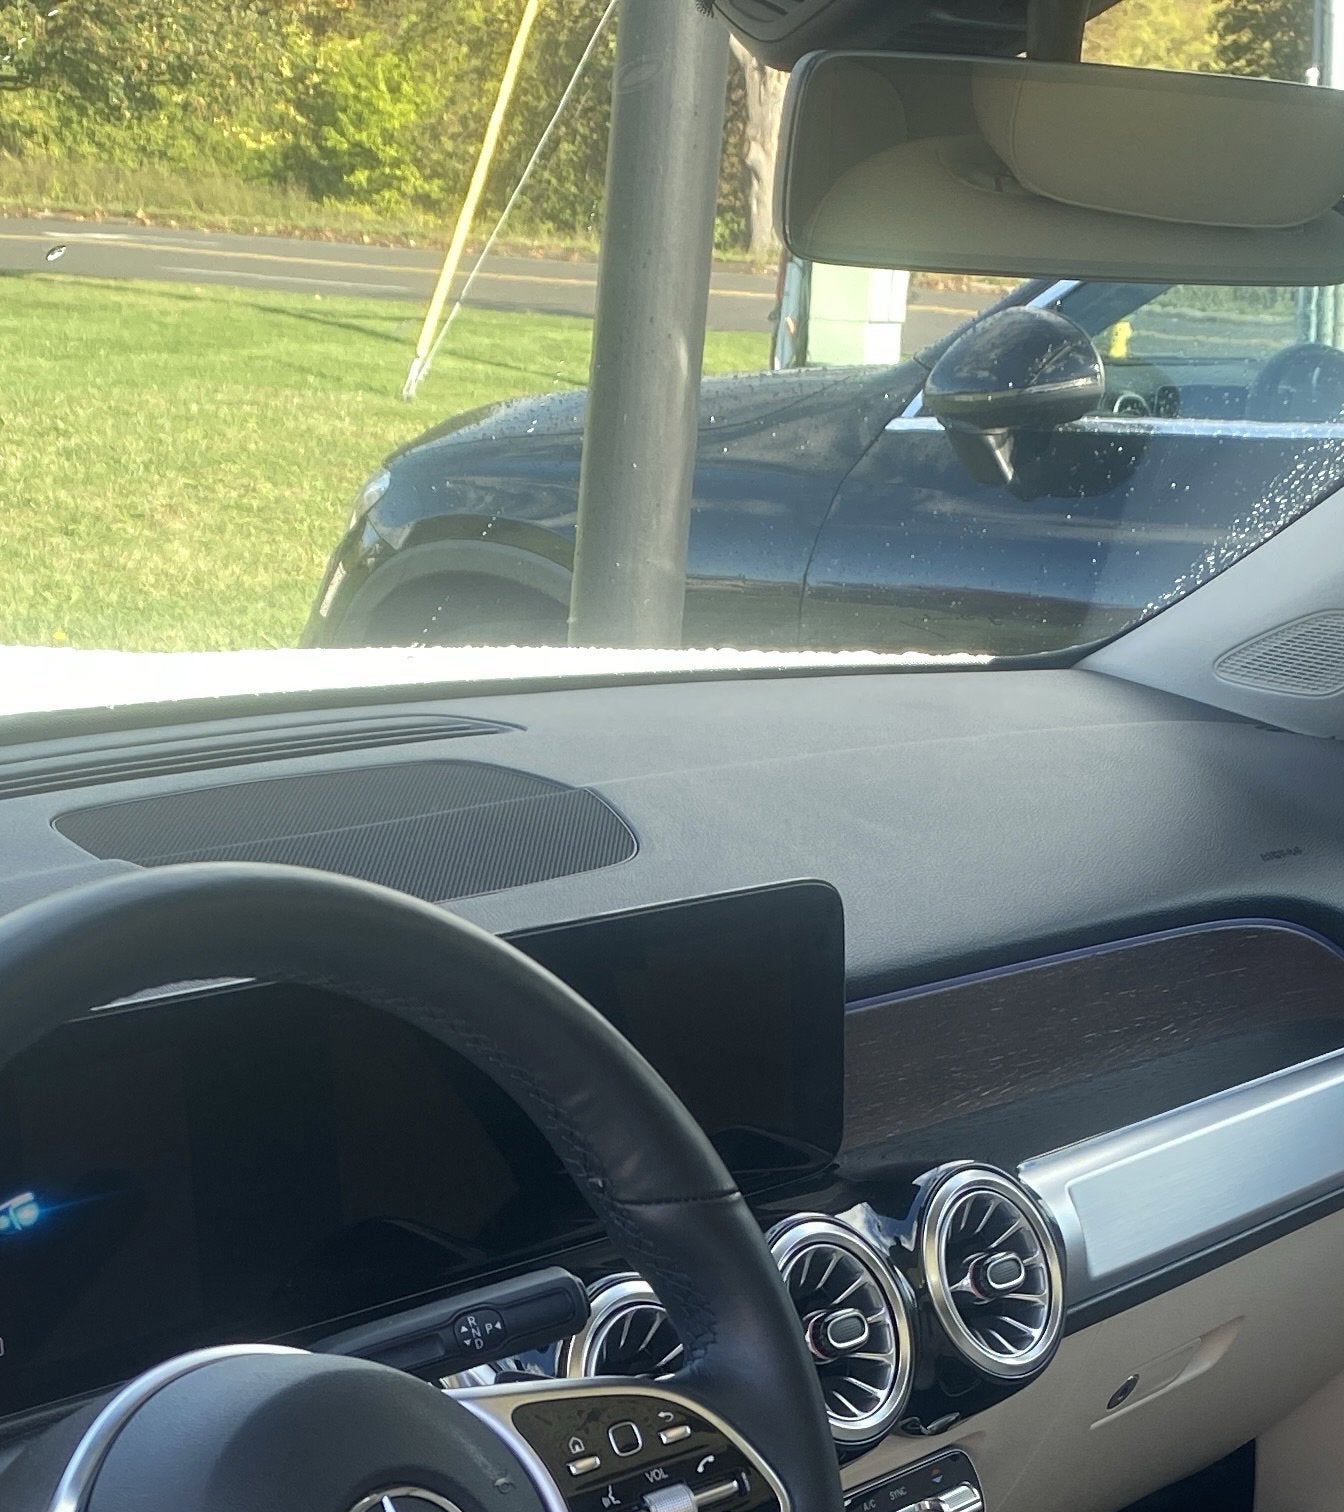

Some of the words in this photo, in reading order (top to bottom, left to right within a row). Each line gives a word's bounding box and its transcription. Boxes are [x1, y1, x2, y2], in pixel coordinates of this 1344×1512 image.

[467, 1316, 477, 1327] R
[471, 1326, 482, 1338] N
[485, 1323, 493, 1334] P
[475, 1338, 484, 1350] D
[644, 1467, 669, 1483] VOL
[889, 1485, 908, 1500] SYNC
[863, 1499, 876, 1511] A/C
